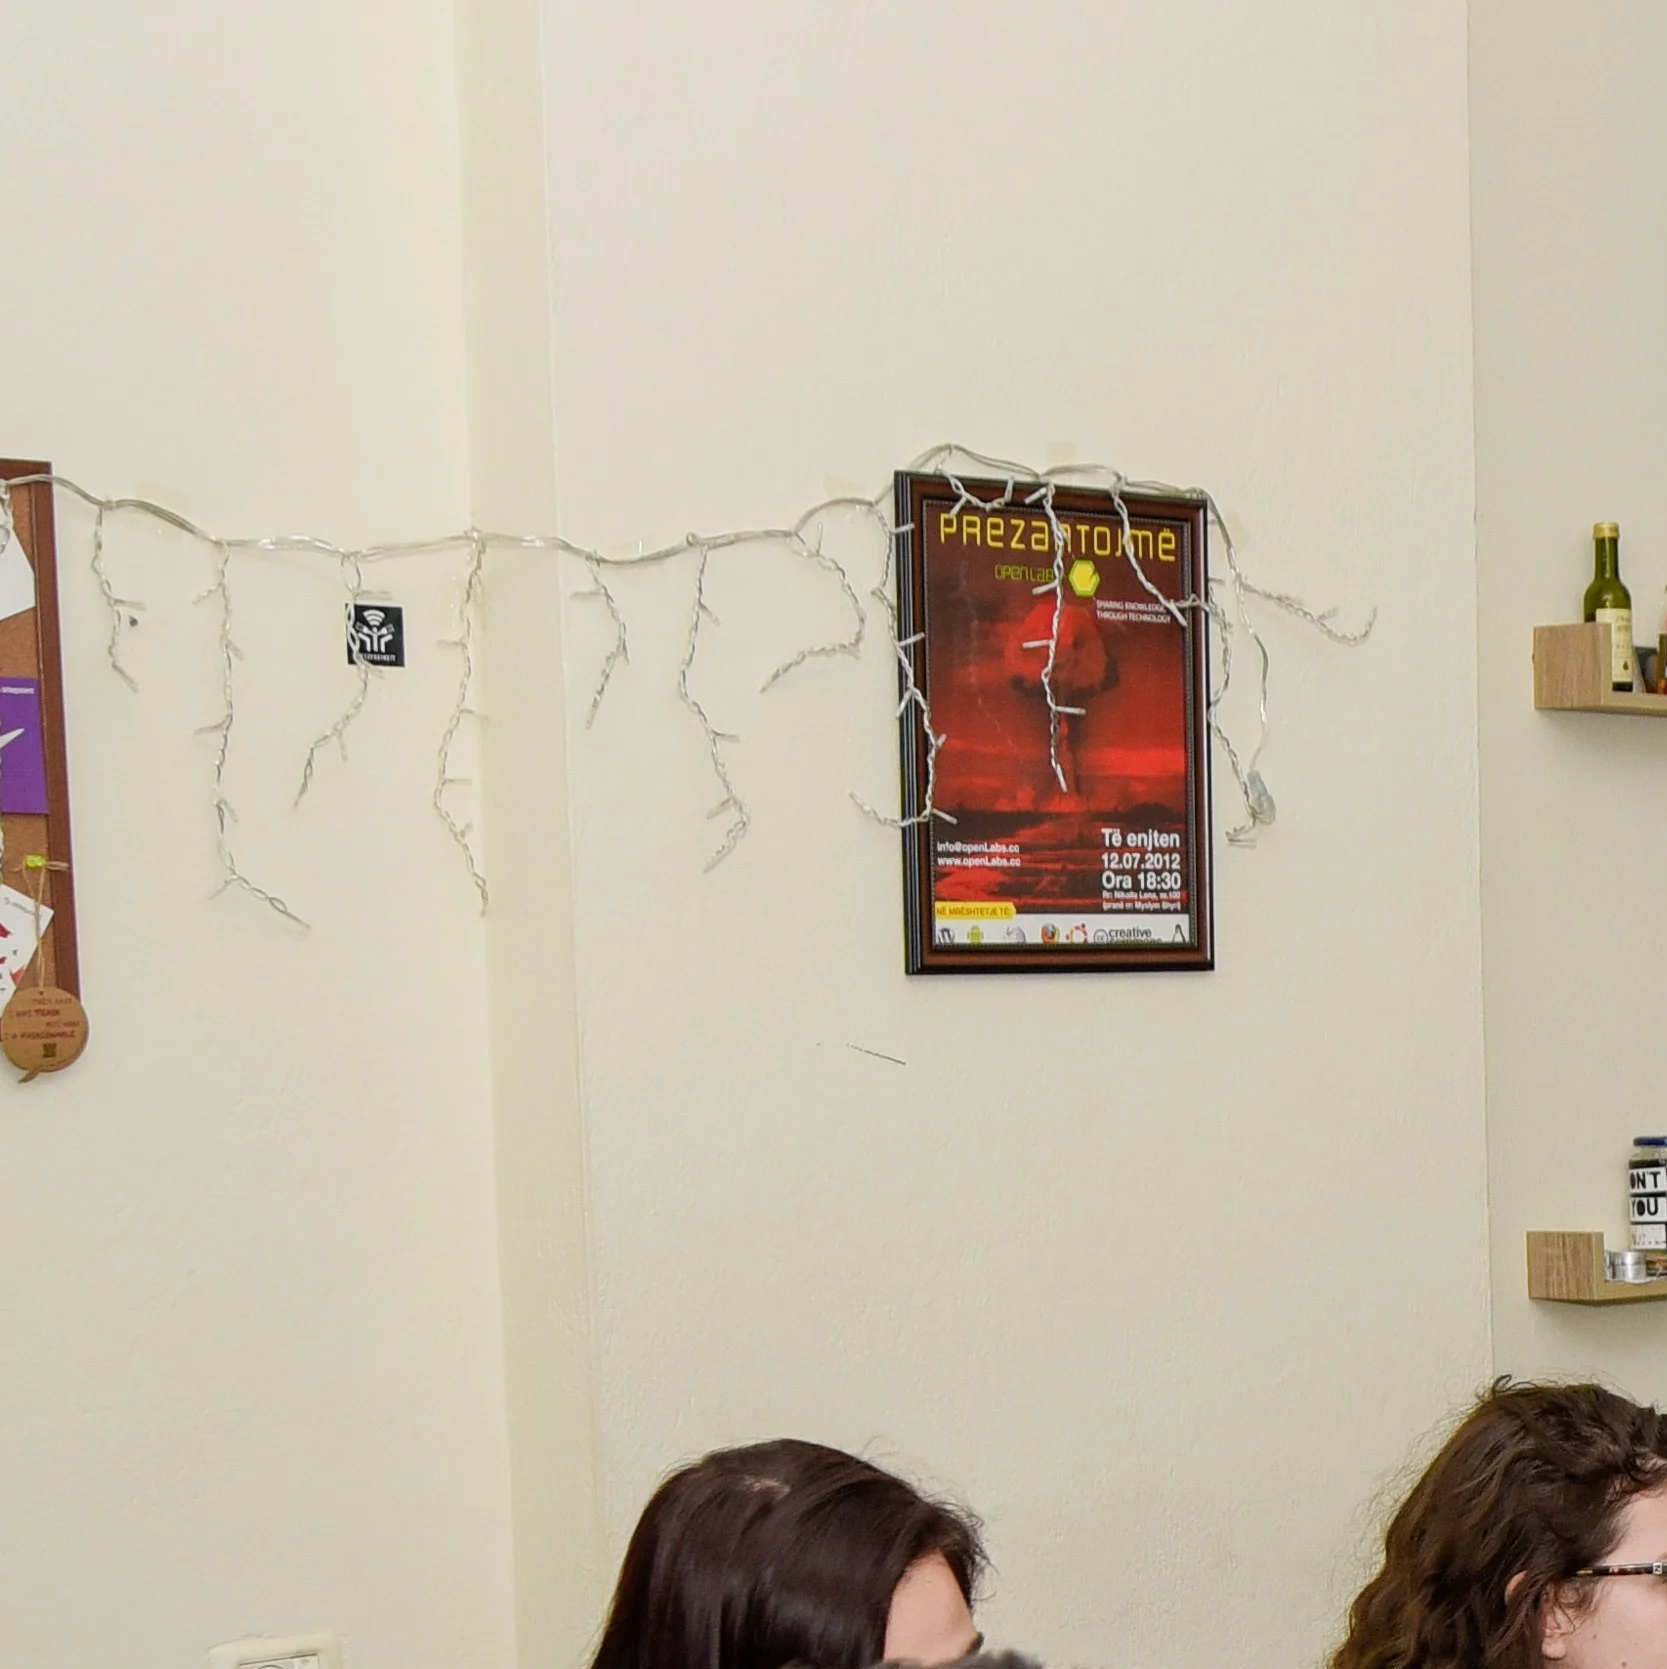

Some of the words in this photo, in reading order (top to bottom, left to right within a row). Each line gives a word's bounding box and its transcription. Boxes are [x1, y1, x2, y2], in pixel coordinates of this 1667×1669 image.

[1097, 611, 1128, 621] THROUGH
[1129, 612, 1171, 624] TECHNOLOGY
[1101, 828, 1122, 848] Të
[1126, 828, 1180, 851] enjten
[1102, 852, 1180, 869] 12.07.2012
[1102, 870, 1132, 889] Ora
[1138, 871, 1181, 889] 18:30
[1109, 927, 1152, 939] creative
[1631, 1198, 1658, 1217] YOU
